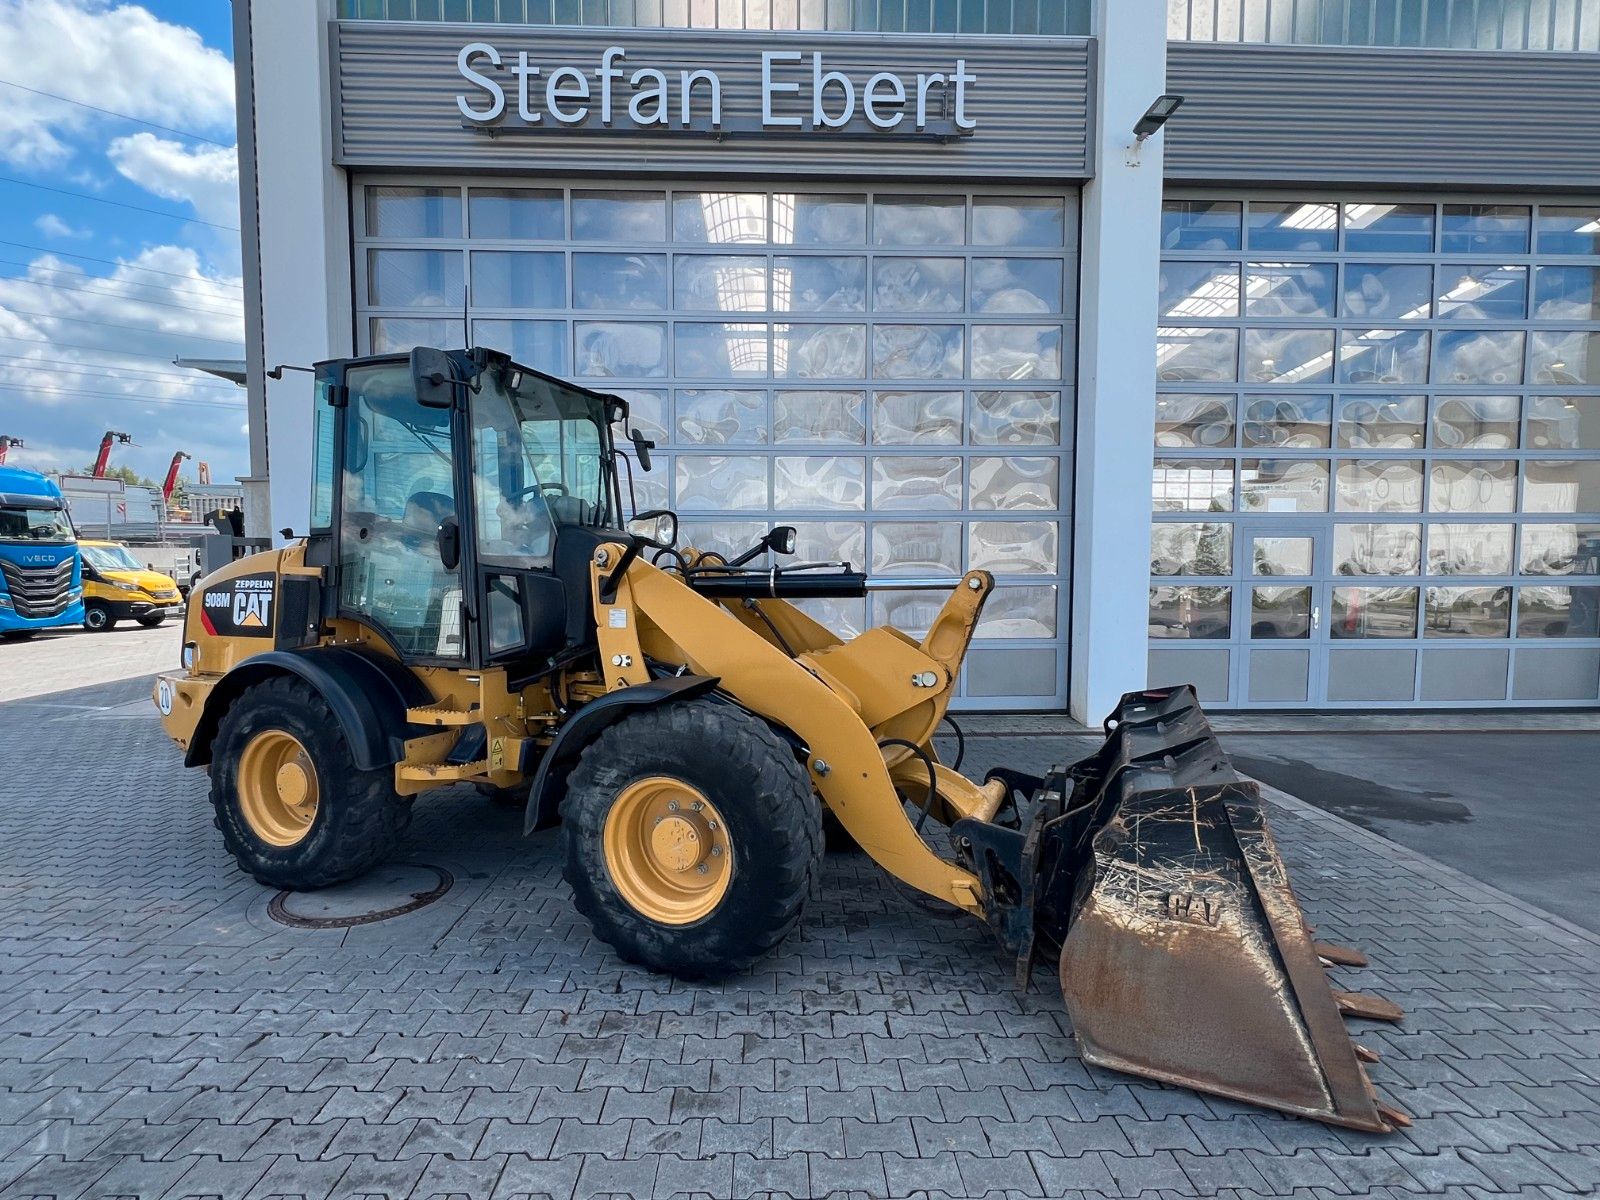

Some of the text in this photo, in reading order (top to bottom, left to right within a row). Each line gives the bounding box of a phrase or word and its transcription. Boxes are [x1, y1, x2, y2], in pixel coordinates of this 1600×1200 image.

[456, 42, 978, 129] Stefan Ebert
[234, 579, 273, 589] ZEPPELIN
[204, 592, 231, 608] 908M
[232, 592, 273, 627] CAT
[160, 686, 170, 709] 20
[1168, 892, 1221, 928] CAT
